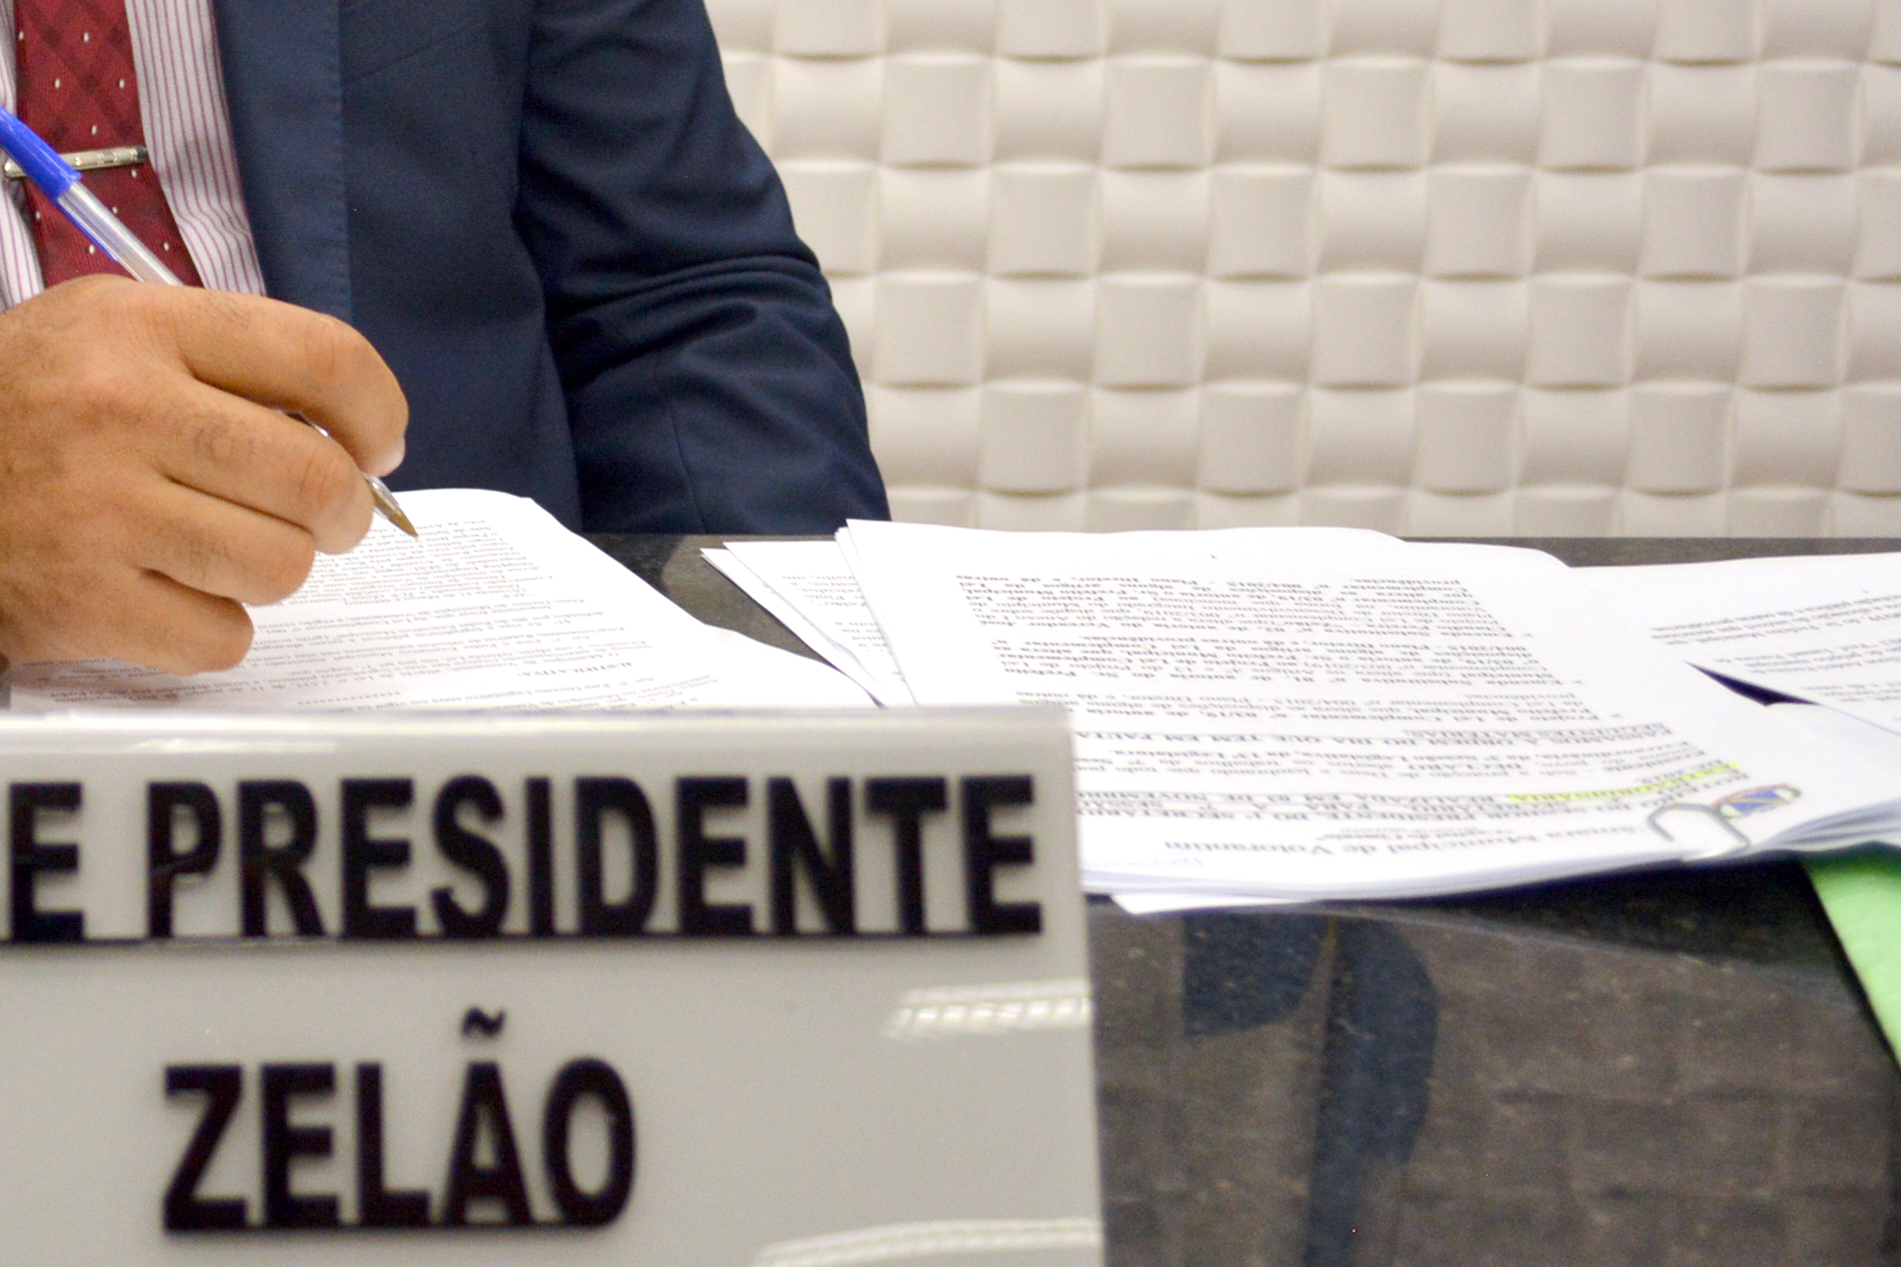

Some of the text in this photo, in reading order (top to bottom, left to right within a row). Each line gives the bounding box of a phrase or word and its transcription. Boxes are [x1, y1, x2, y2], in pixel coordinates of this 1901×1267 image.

[143, 774, 1044, 940] PRESIDENTE
[1545, 825, 1637, 841] âmara
[162, 1007, 639, 1234] ZELÃO
